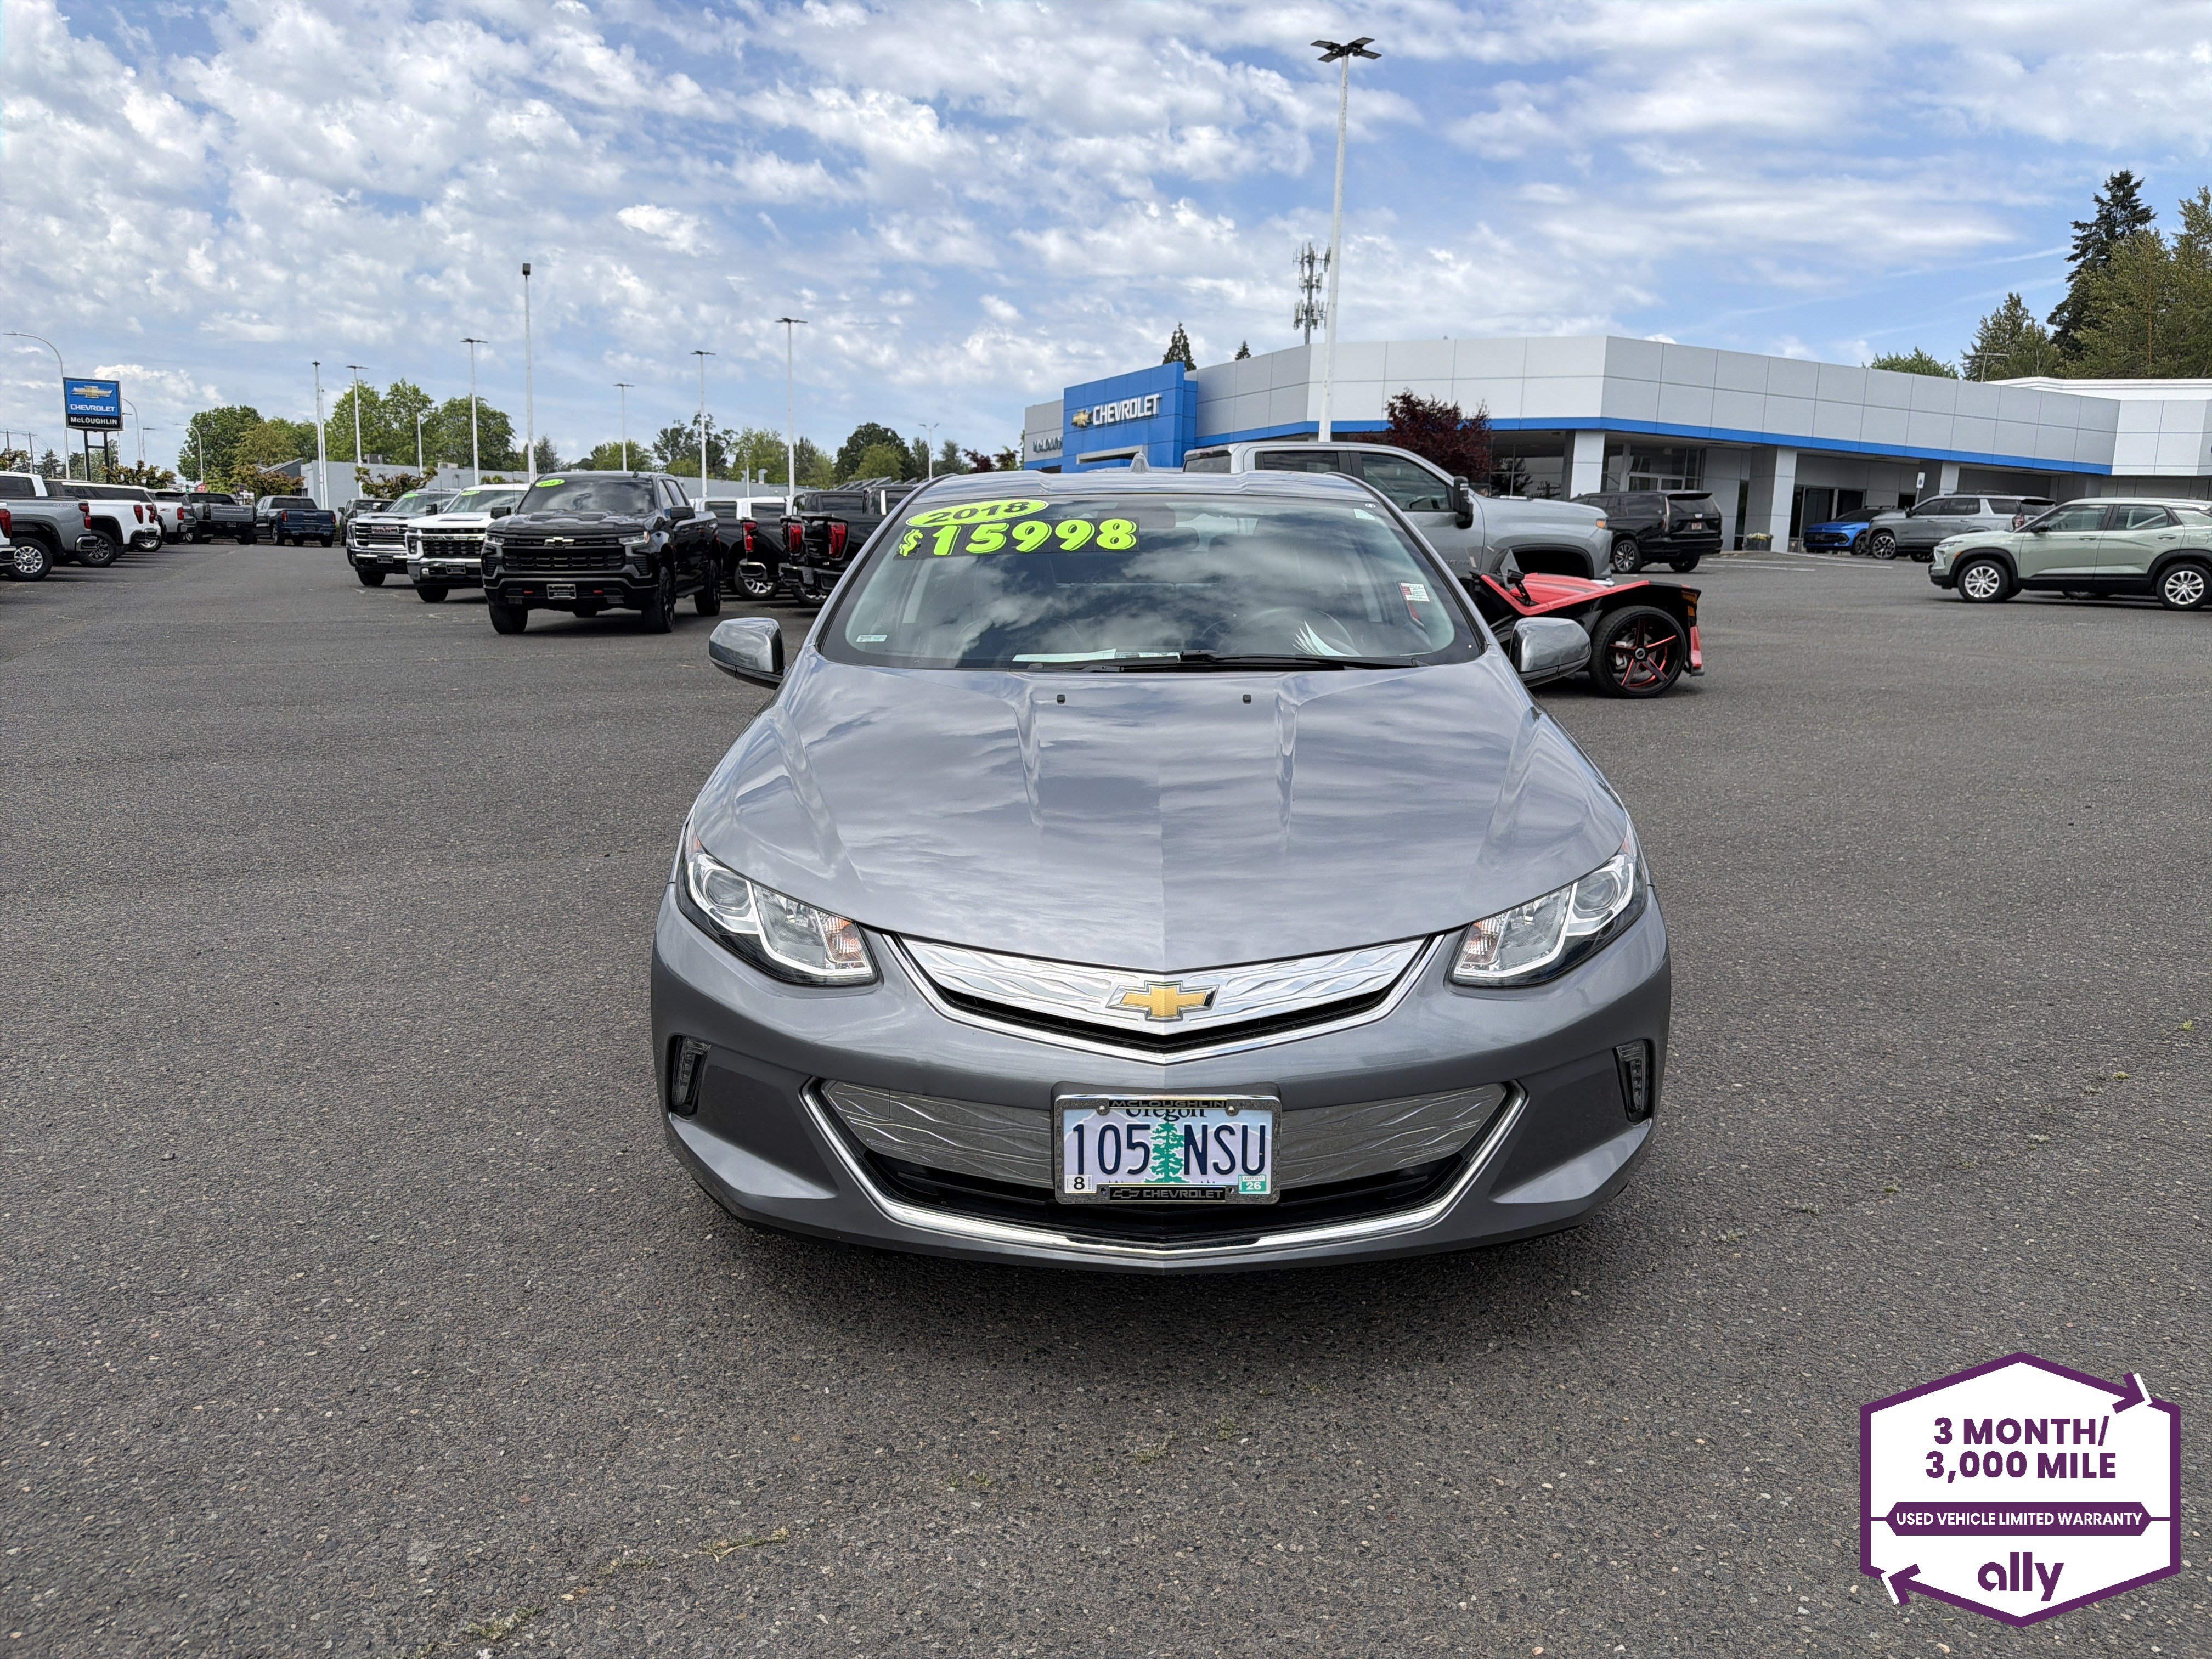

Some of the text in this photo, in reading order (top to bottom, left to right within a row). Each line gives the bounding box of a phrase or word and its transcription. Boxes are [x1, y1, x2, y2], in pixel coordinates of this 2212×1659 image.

[70, 404, 115, 412] CHEVROLET
[1093, 394, 1159, 425] CHEVROLET
[928, 501, 1032, 524] 2018
[898, 519, 1137, 557] $15998
[1073, 1124, 1266, 1176] 105 NSU
[1073, 1176, 1085, 1190] 8
[1246, 1182, 1261, 1190] 26
[1143, 1189, 1223, 1198] CHEVROLET
